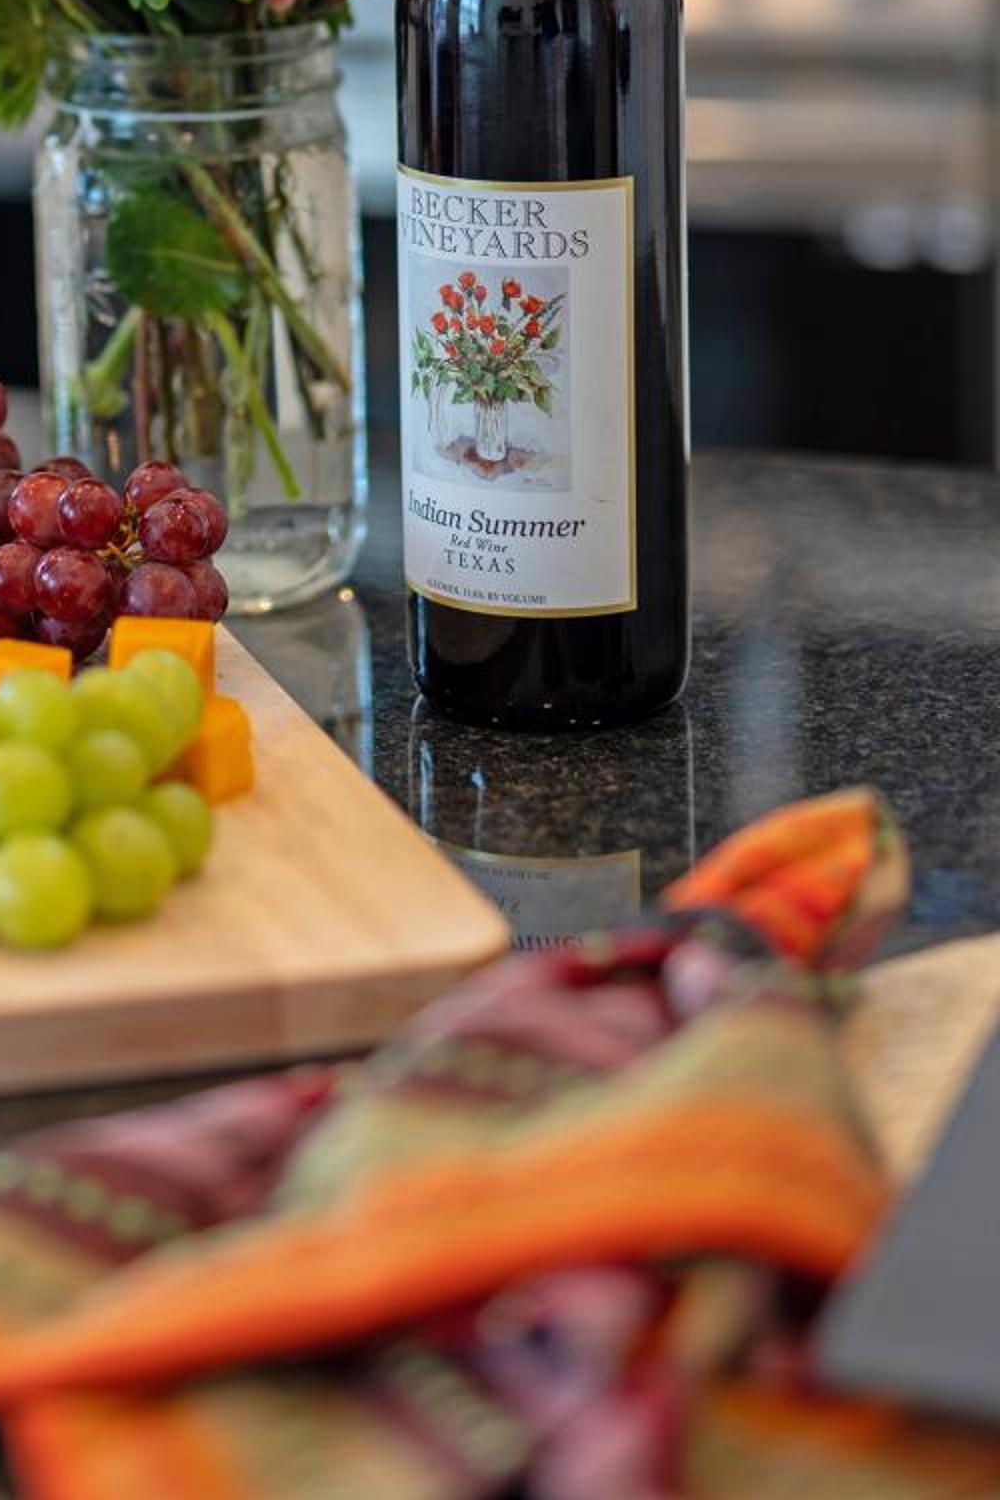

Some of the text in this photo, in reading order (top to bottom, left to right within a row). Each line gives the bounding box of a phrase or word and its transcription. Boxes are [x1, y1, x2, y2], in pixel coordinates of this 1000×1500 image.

[411, 186, 549, 229] BECKER
[401, 212, 590, 260] VINEYARDS
[408, 489, 586, 539] Indian Summer
[443, 548, 516, 575] TEXAS
[450, 533, 508, 553] Red Wine
